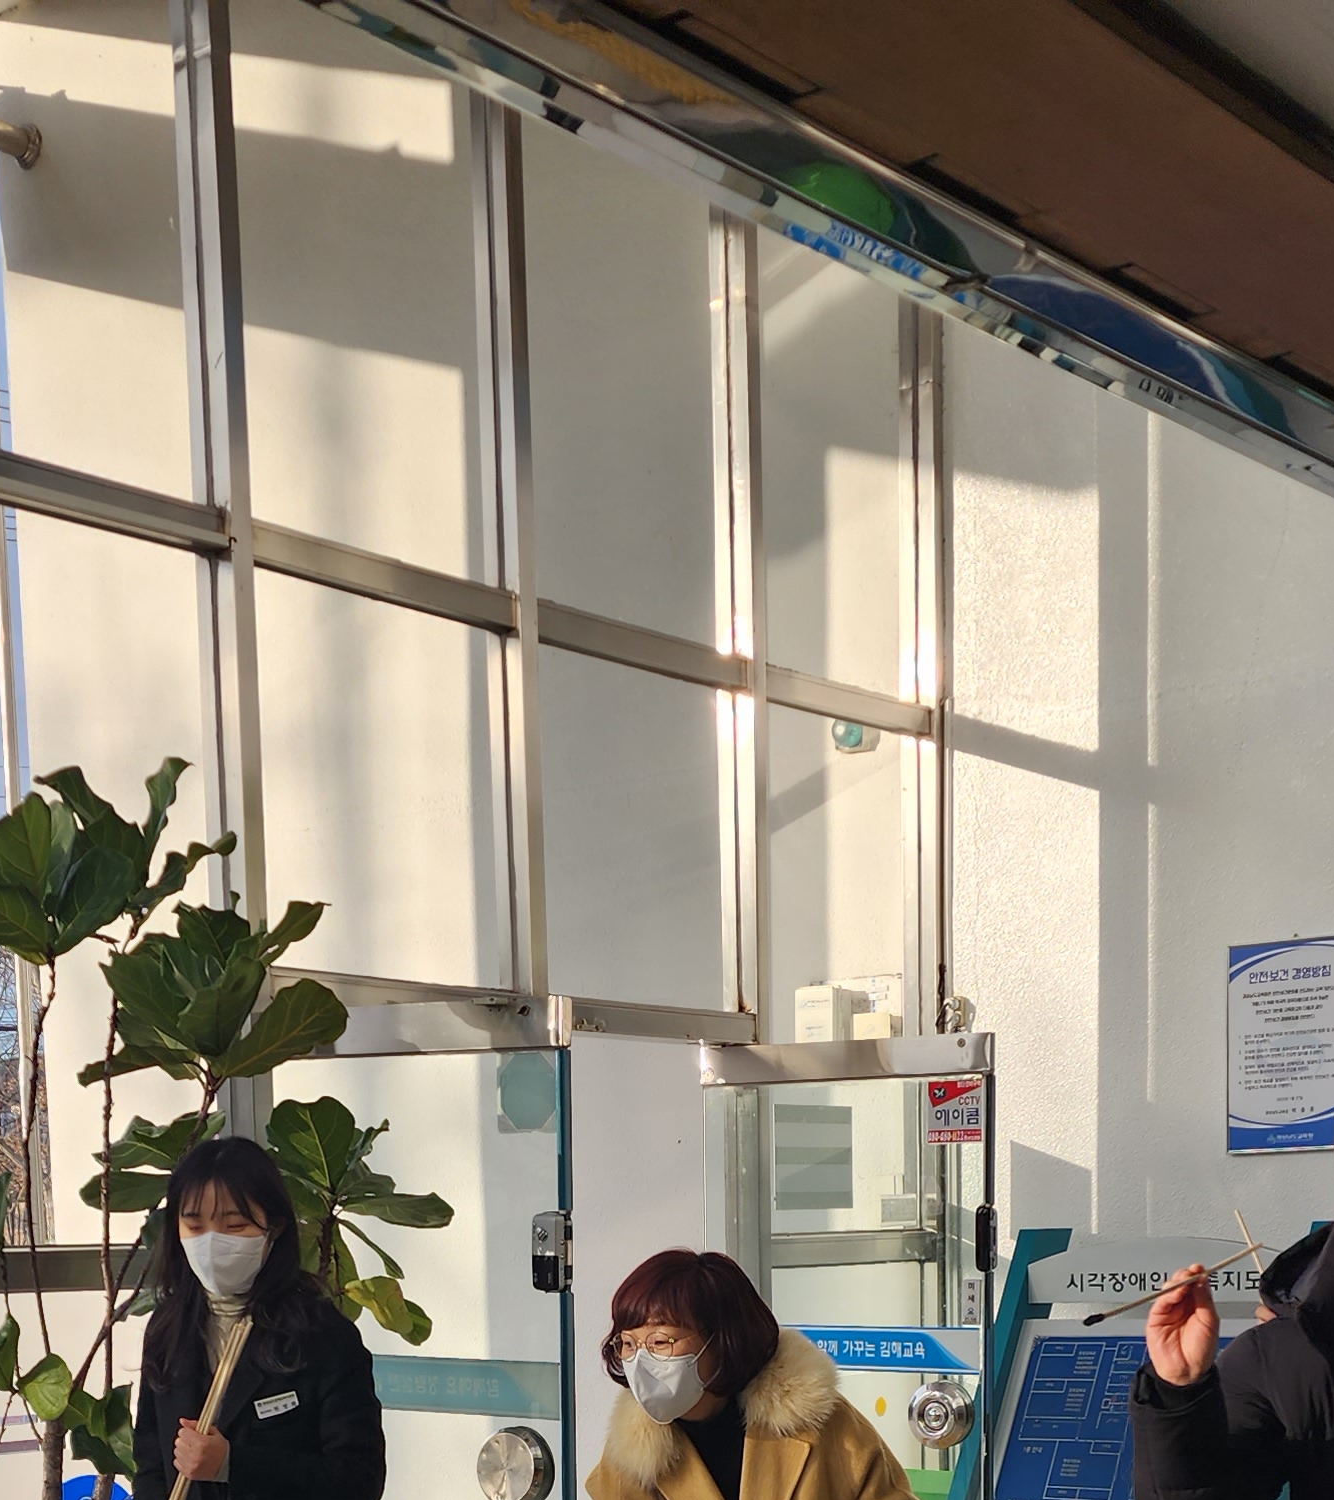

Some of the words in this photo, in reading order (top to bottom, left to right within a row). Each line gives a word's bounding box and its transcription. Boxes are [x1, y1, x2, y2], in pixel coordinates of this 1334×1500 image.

[1292, 964, 1331, 980] 경영방침
[958, 1096, 980, 1106] CCTV
[842, 1340, 876, 1358] 가꾸는
[879, 1341, 925, 1359] 김해교육
